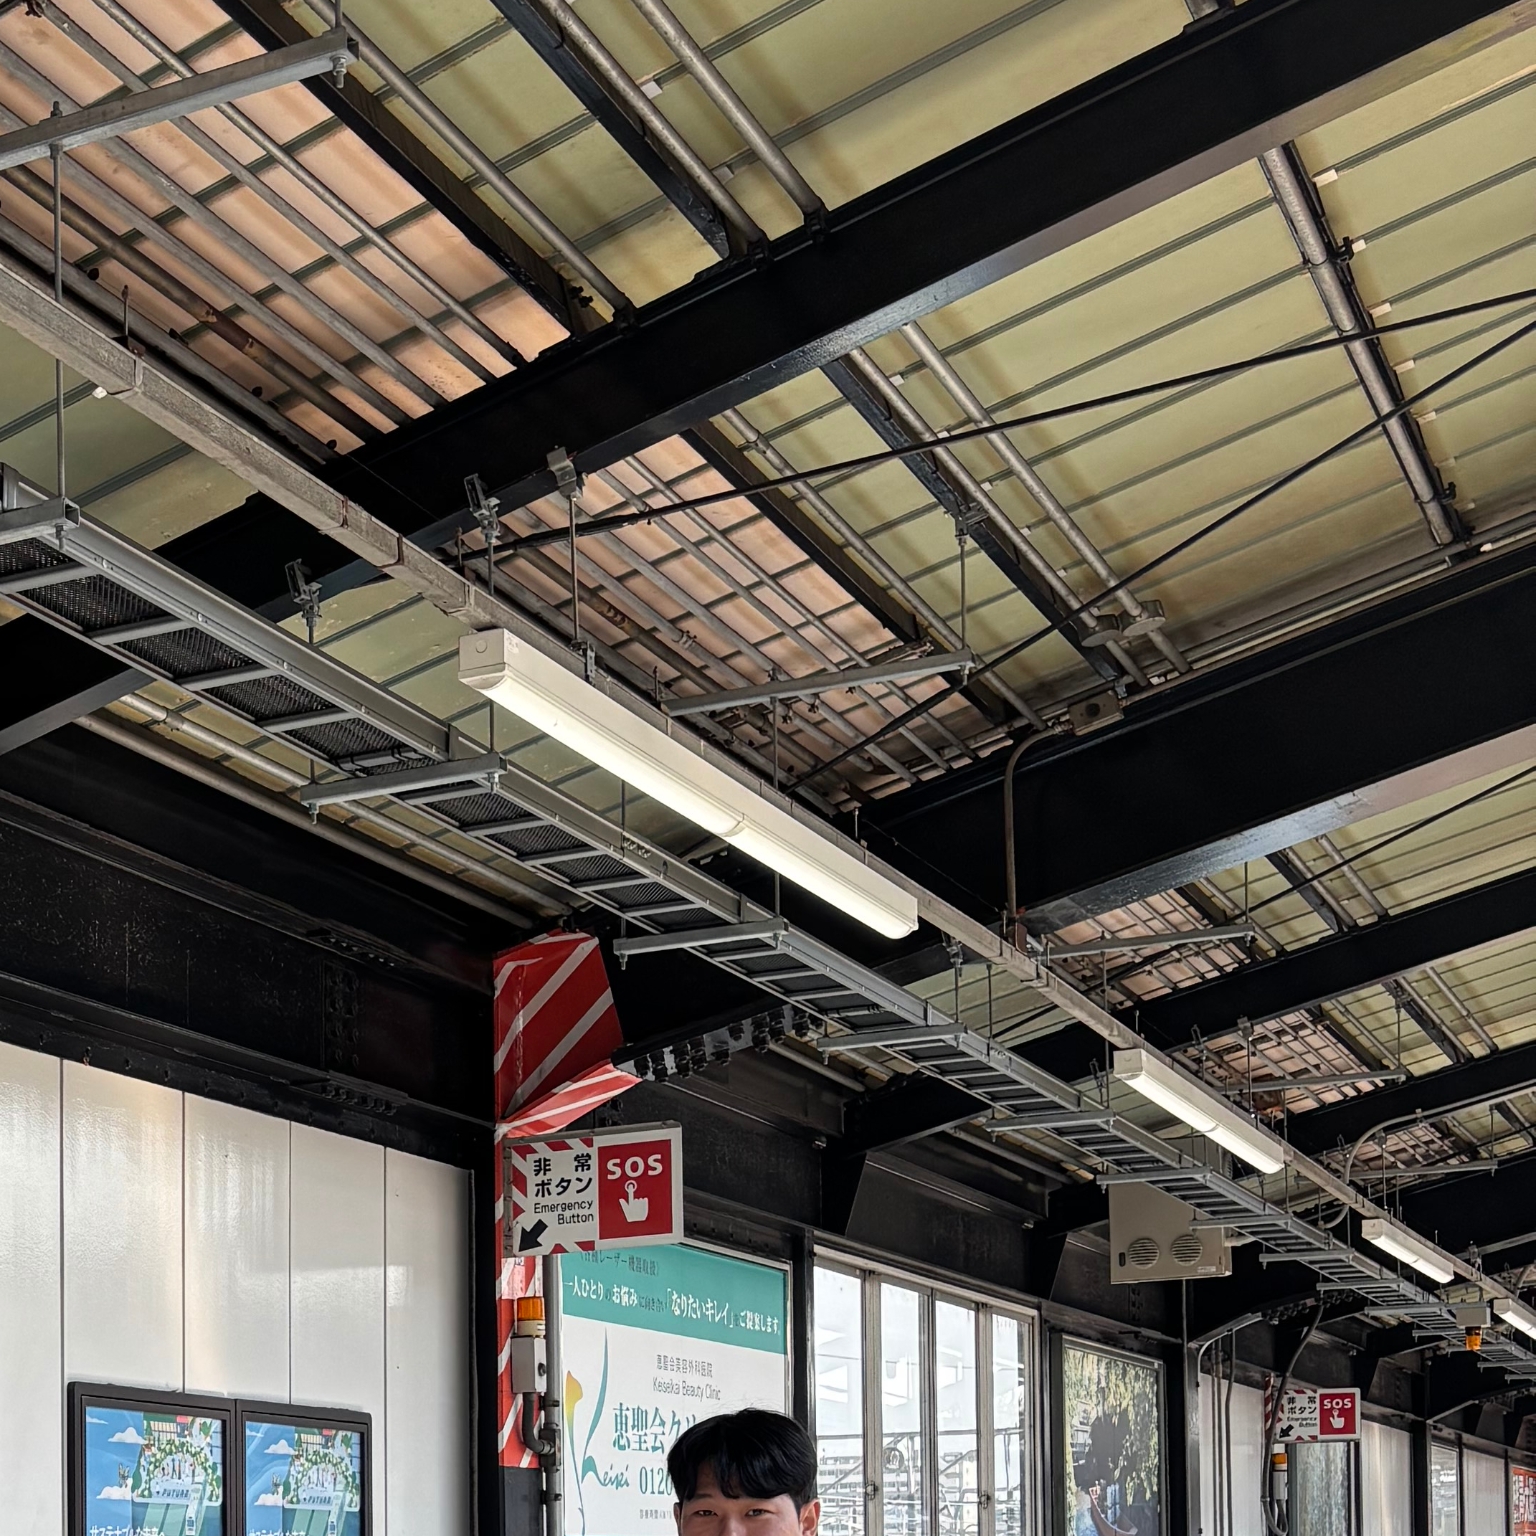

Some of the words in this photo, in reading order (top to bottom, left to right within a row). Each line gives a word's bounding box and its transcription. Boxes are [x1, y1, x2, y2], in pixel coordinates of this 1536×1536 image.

[606, 1154, 663, 1180] SOS
[534, 1177, 593, 1198] ボタン
[534, 1200, 593, 1214] Emergency
[558, 1212, 594, 1225] Button
[705, 1384, 721, 1400] Clinic
[1287, 1406, 1317, 1415] ボタン
[1324, 1399, 1352, 1409] SOS
